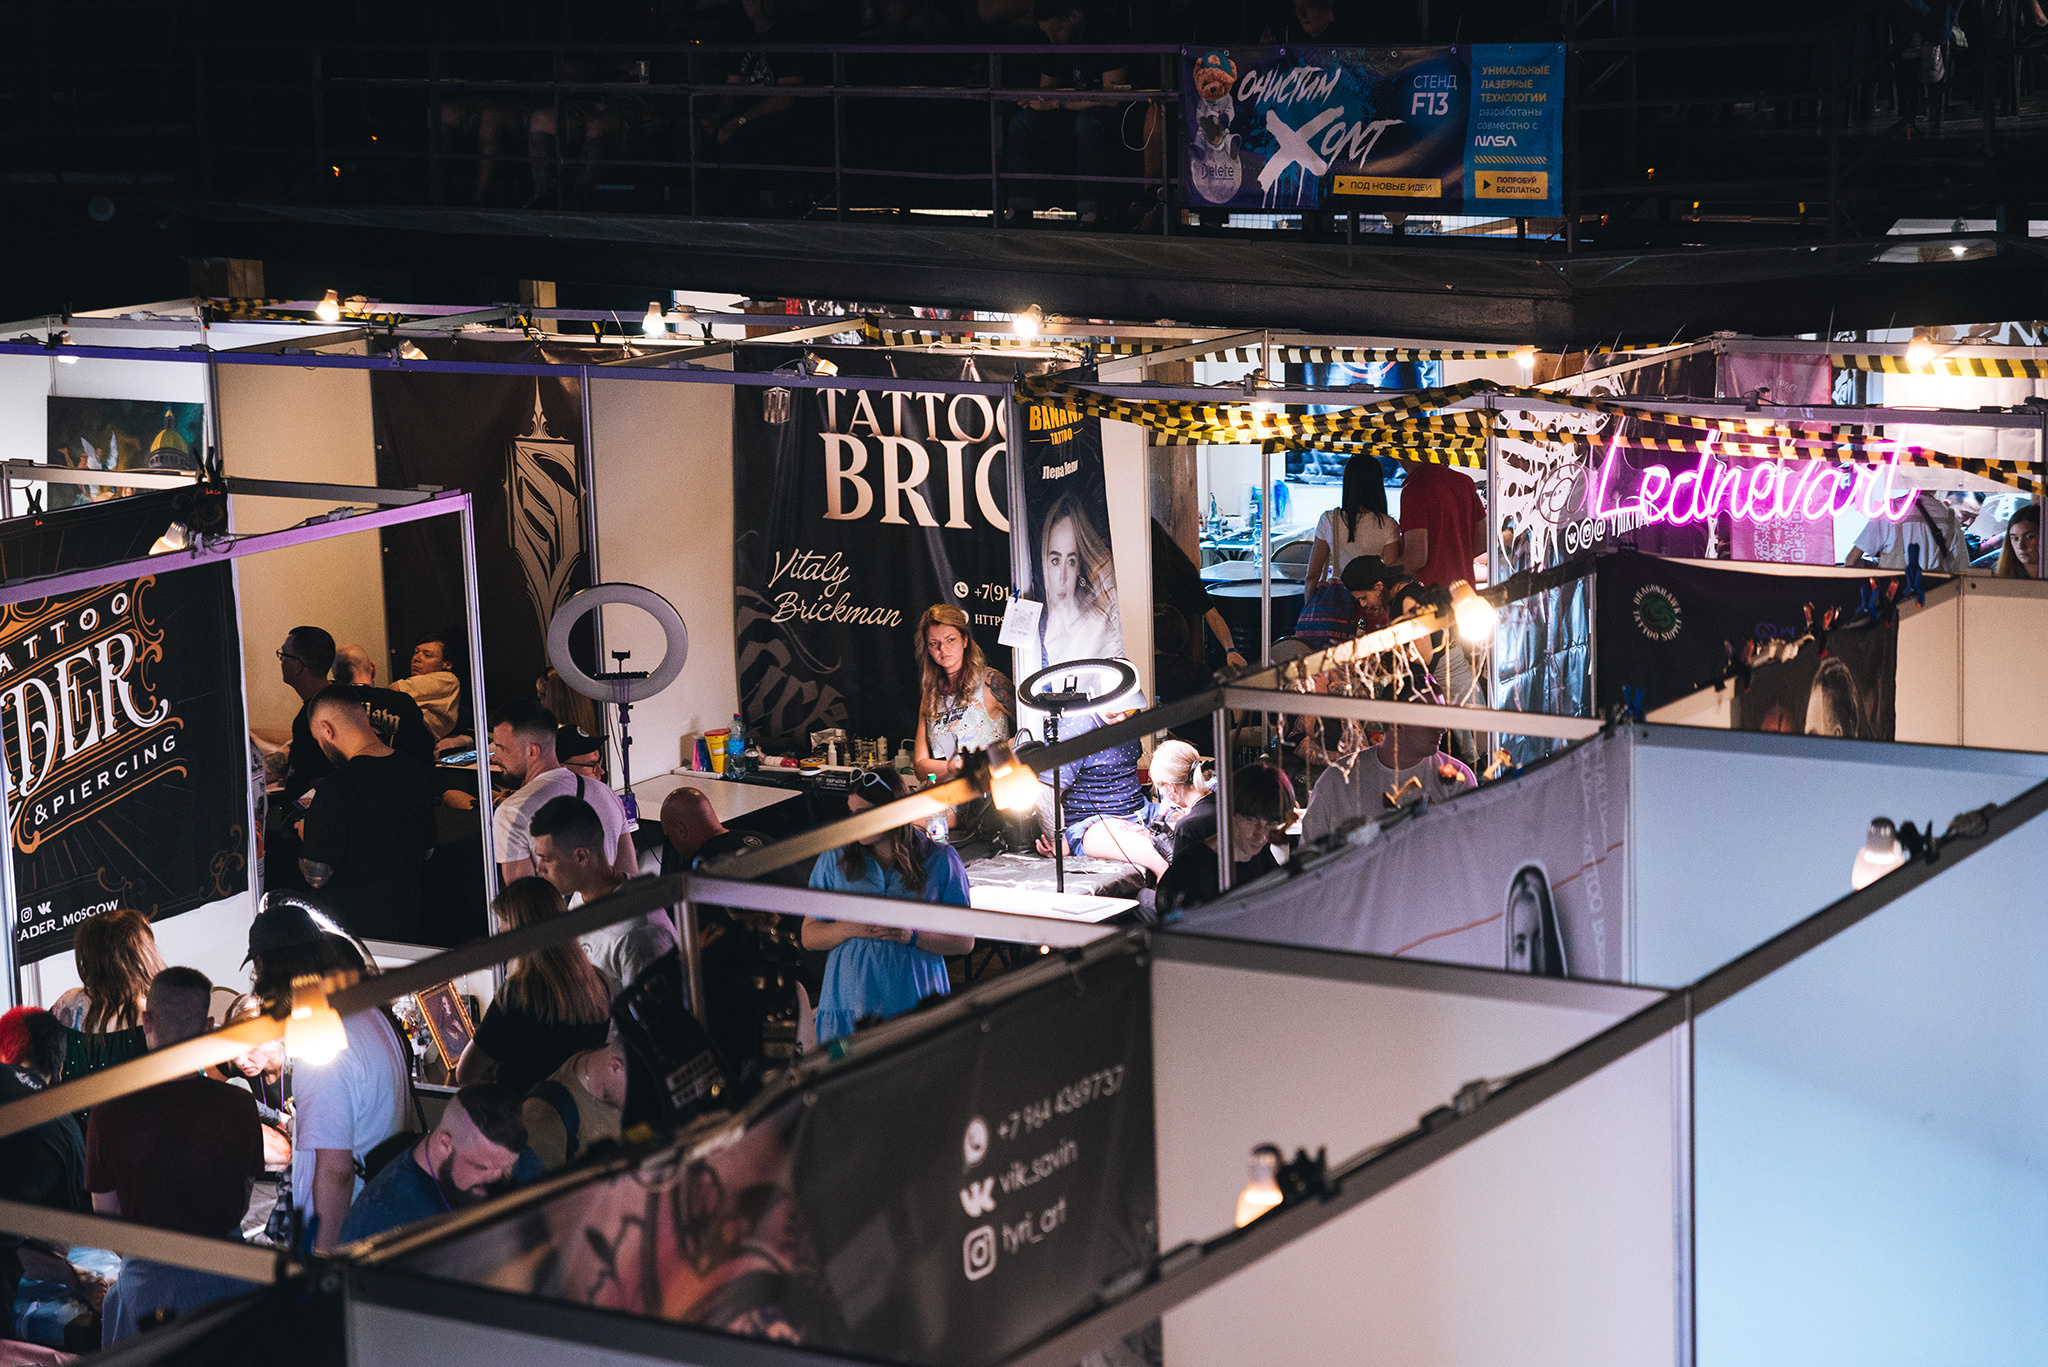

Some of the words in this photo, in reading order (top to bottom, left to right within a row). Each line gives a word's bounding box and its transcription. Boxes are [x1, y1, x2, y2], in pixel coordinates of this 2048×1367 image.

[1481, 65, 1550, 76] УНИКАЛЬНЫЕ
[1413, 75, 1458, 90] СТЕНД
[1481, 79, 1534, 90] ЛАЗЕРНЫЕ
[1480, 92, 1547, 103] ТЕХНОЛОГИИ
[1411, 92, 1449, 116] F13
[1478, 106, 1543, 118] разработаны
[1477, 121, 1530, 131] совместно
[1475, 135, 1517, 147] NASA
[1496, 176, 1537, 185] ПОПРОБУЙ
[1350, 181, 1370, 191] ПОД
[1372, 182, 1406, 192] НОВЫЕ
[1408, 183, 1432, 193] ИДЕИ
[1496, 186, 1541, 194] БЕСПЛАТНО
[1050, 427, 1073, 445] TATTOO
[768, 548, 851, 598] Vitaly
[770, 592, 902, 628] Brickman
[2, 632, 169, 798] DER
[53, 734, 178, 815] PIERCING
[16, 899, 120, 942] ADER_MOSCOW
